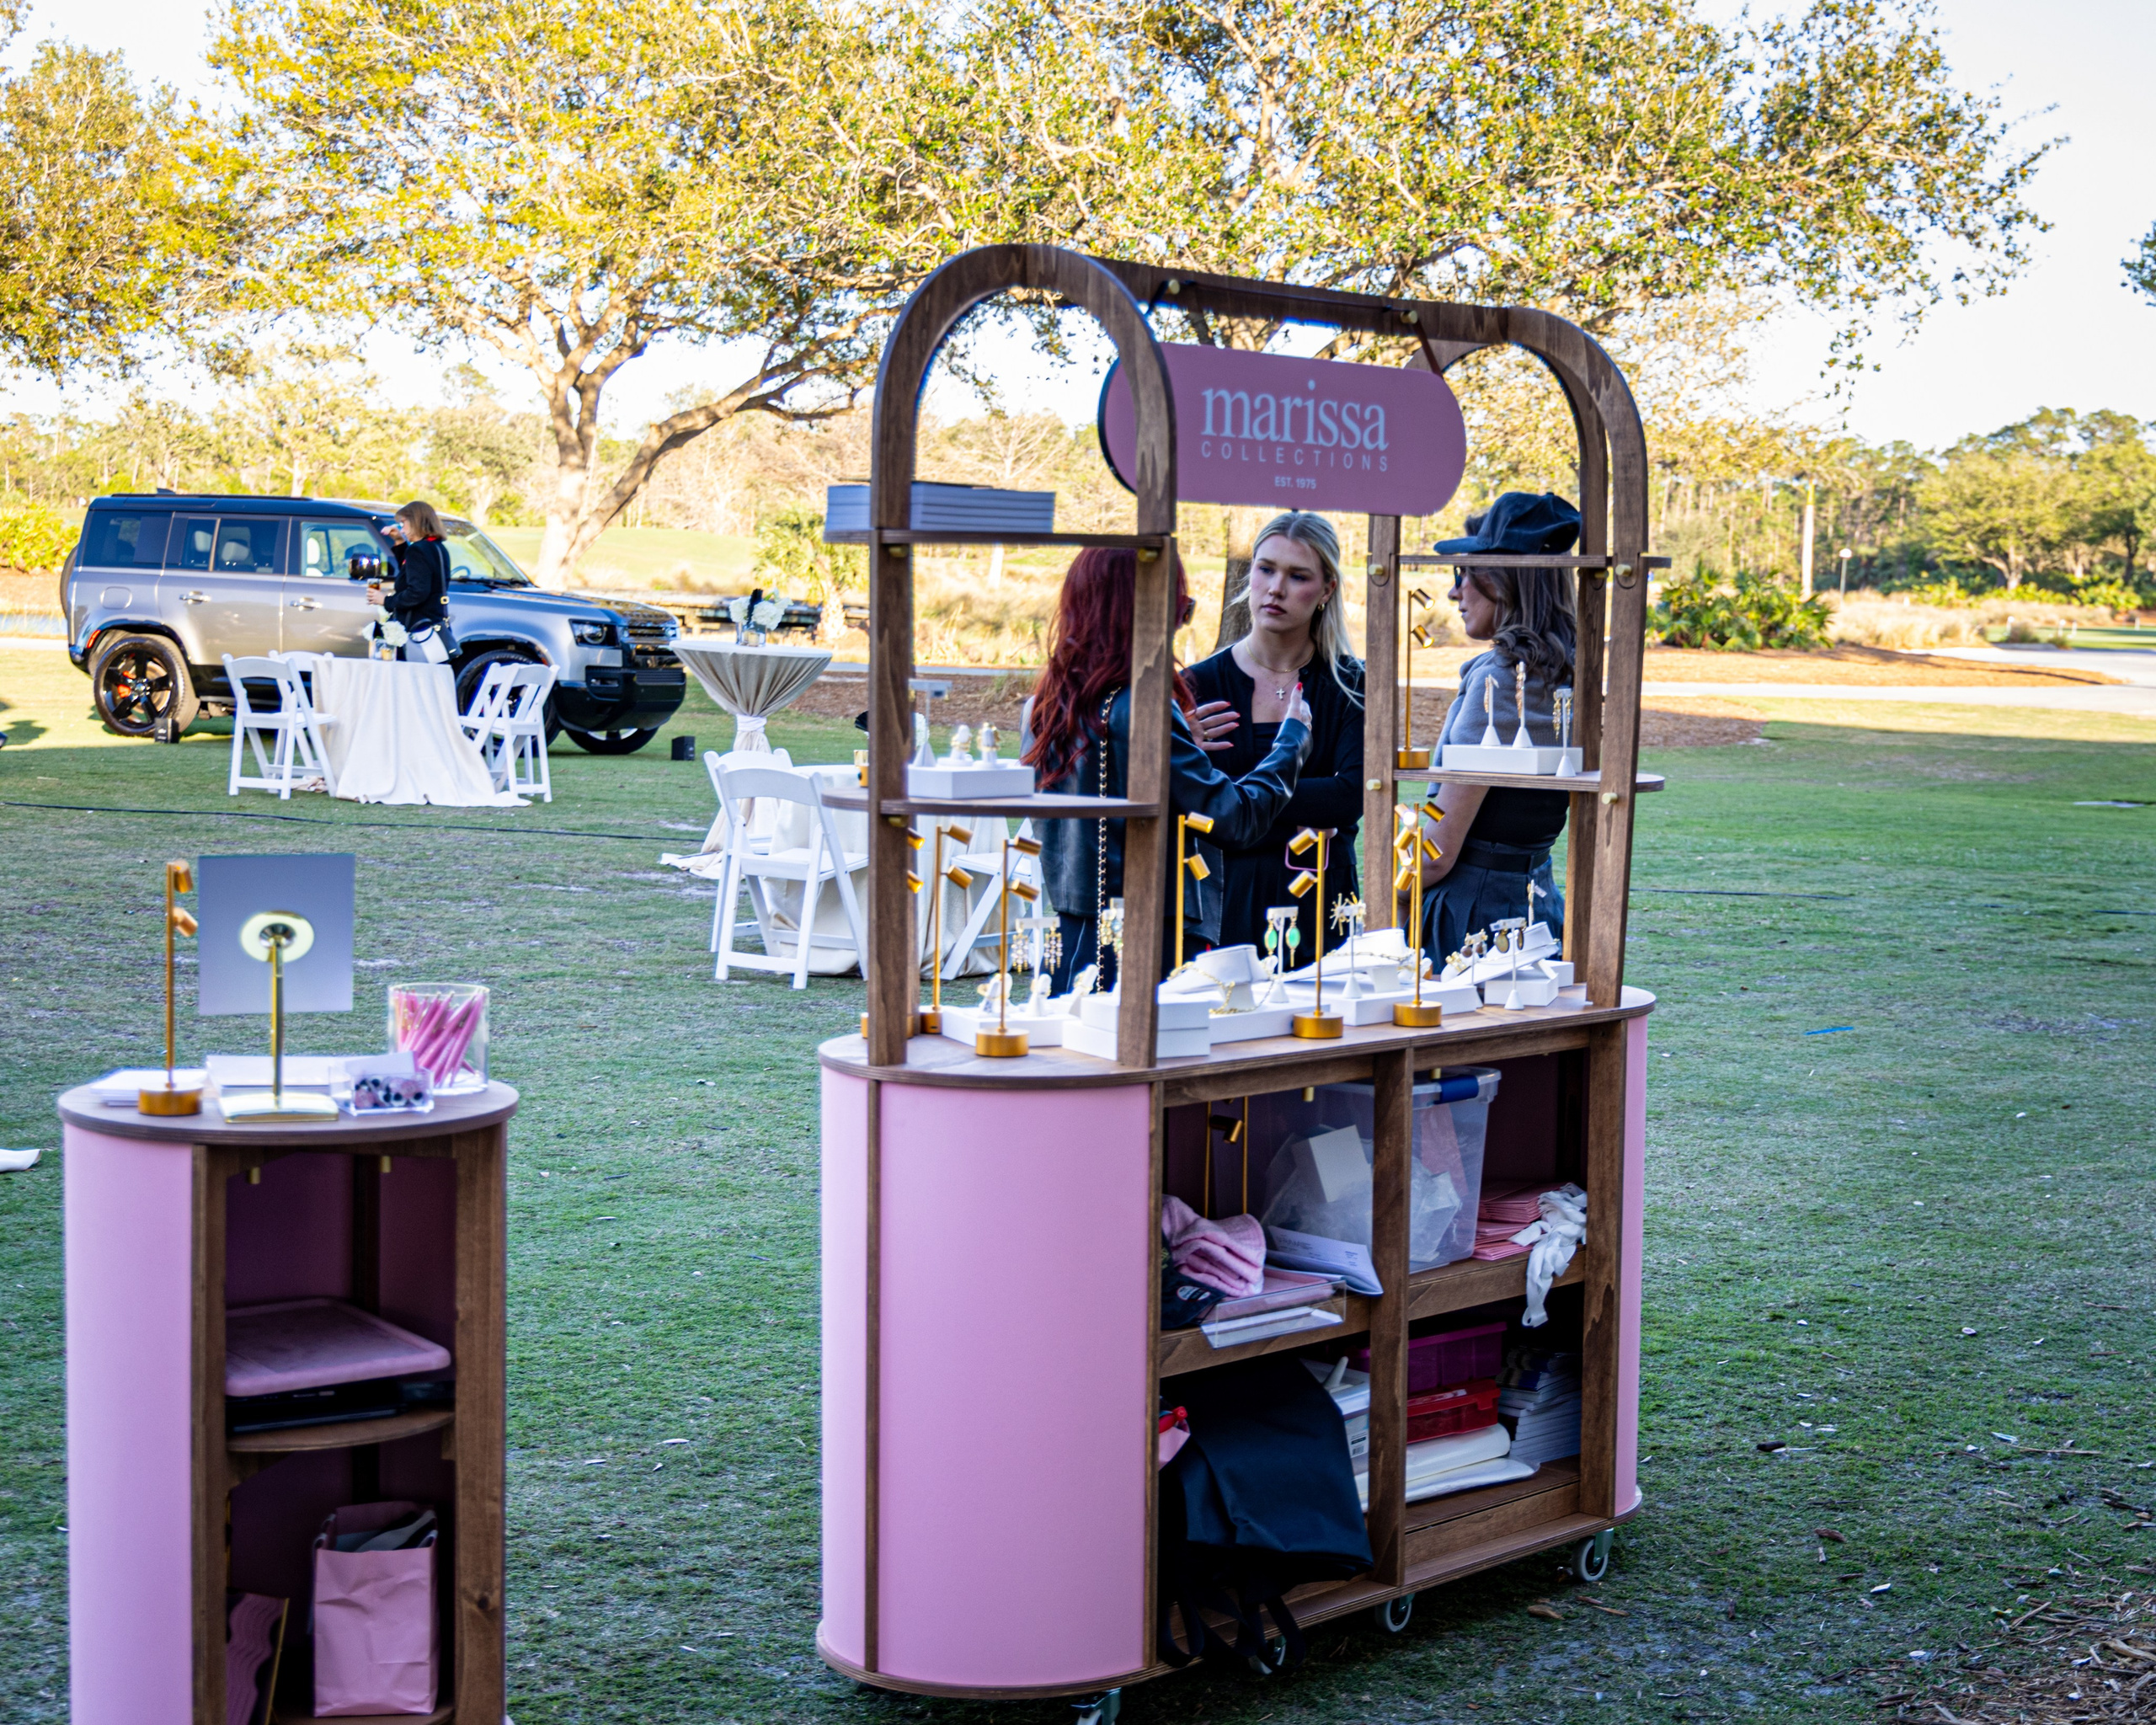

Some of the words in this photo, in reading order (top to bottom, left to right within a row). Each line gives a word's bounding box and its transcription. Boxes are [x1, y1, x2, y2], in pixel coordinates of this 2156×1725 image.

[1201, 380, 1389, 451] marissa
[1202, 441, 1388, 473] COLLECTIONS
[1274, 476, 1294, 489] EST.
[1295, 478, 1316, 490] 1975
